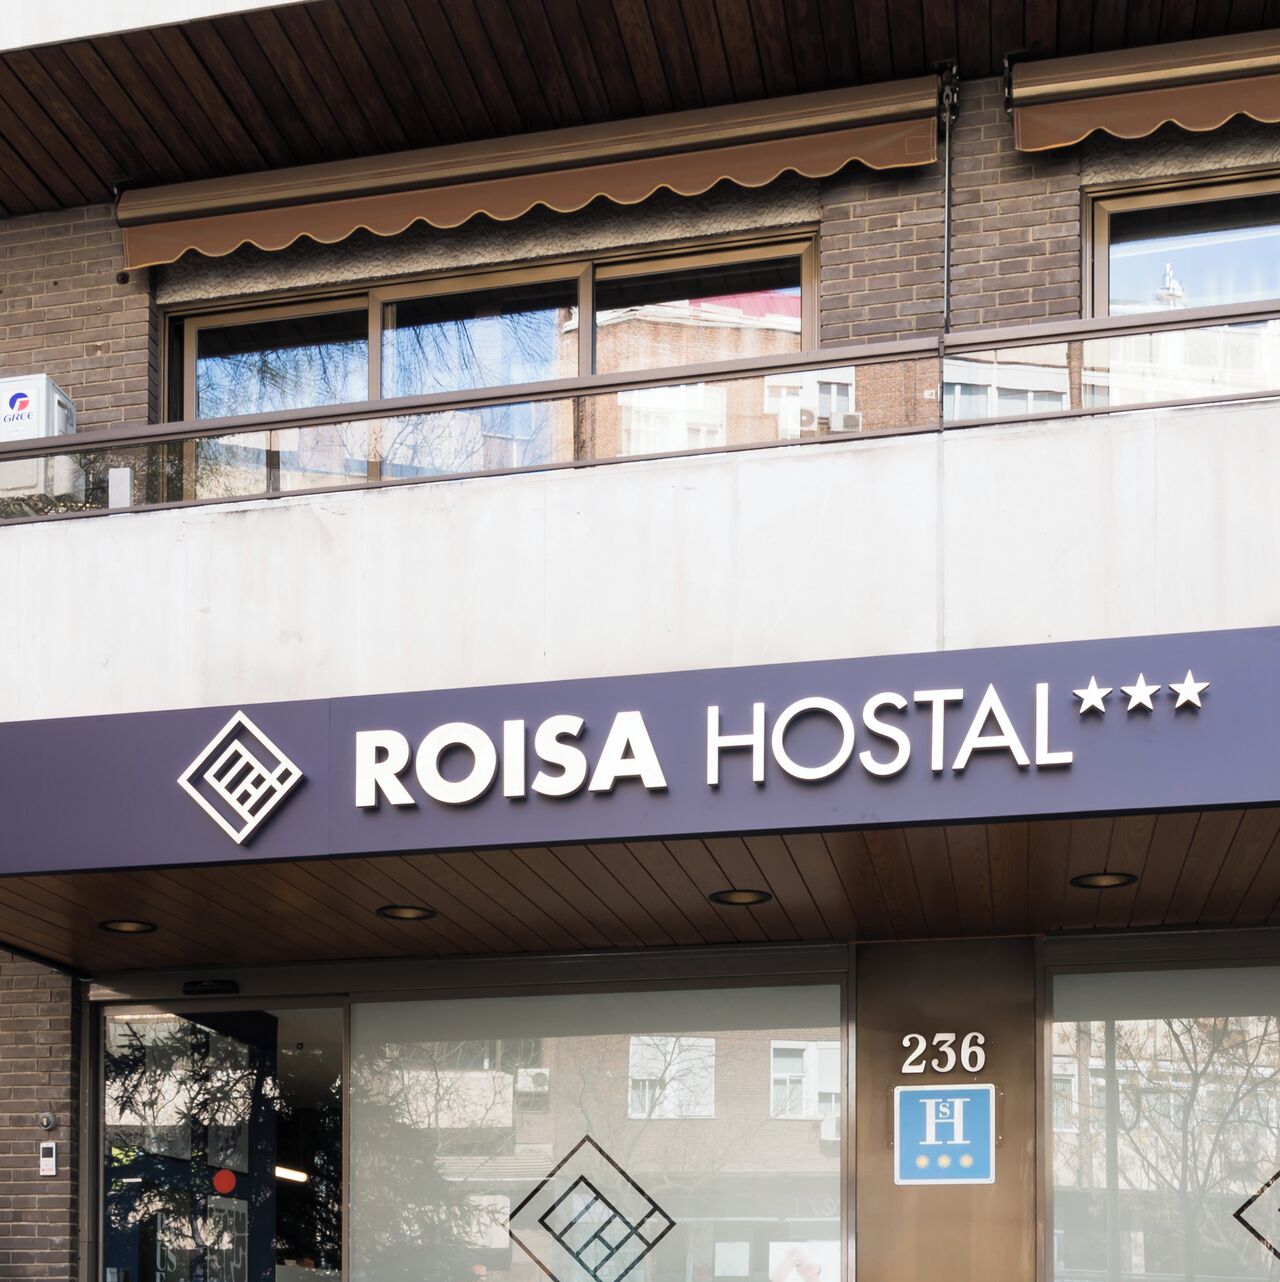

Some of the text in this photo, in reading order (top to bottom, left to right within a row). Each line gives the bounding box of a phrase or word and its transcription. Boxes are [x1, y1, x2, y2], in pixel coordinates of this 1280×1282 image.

[354, 682, 1074, 808] ROISA HOSTAL
[901, 1031, 986, 1074] 236
